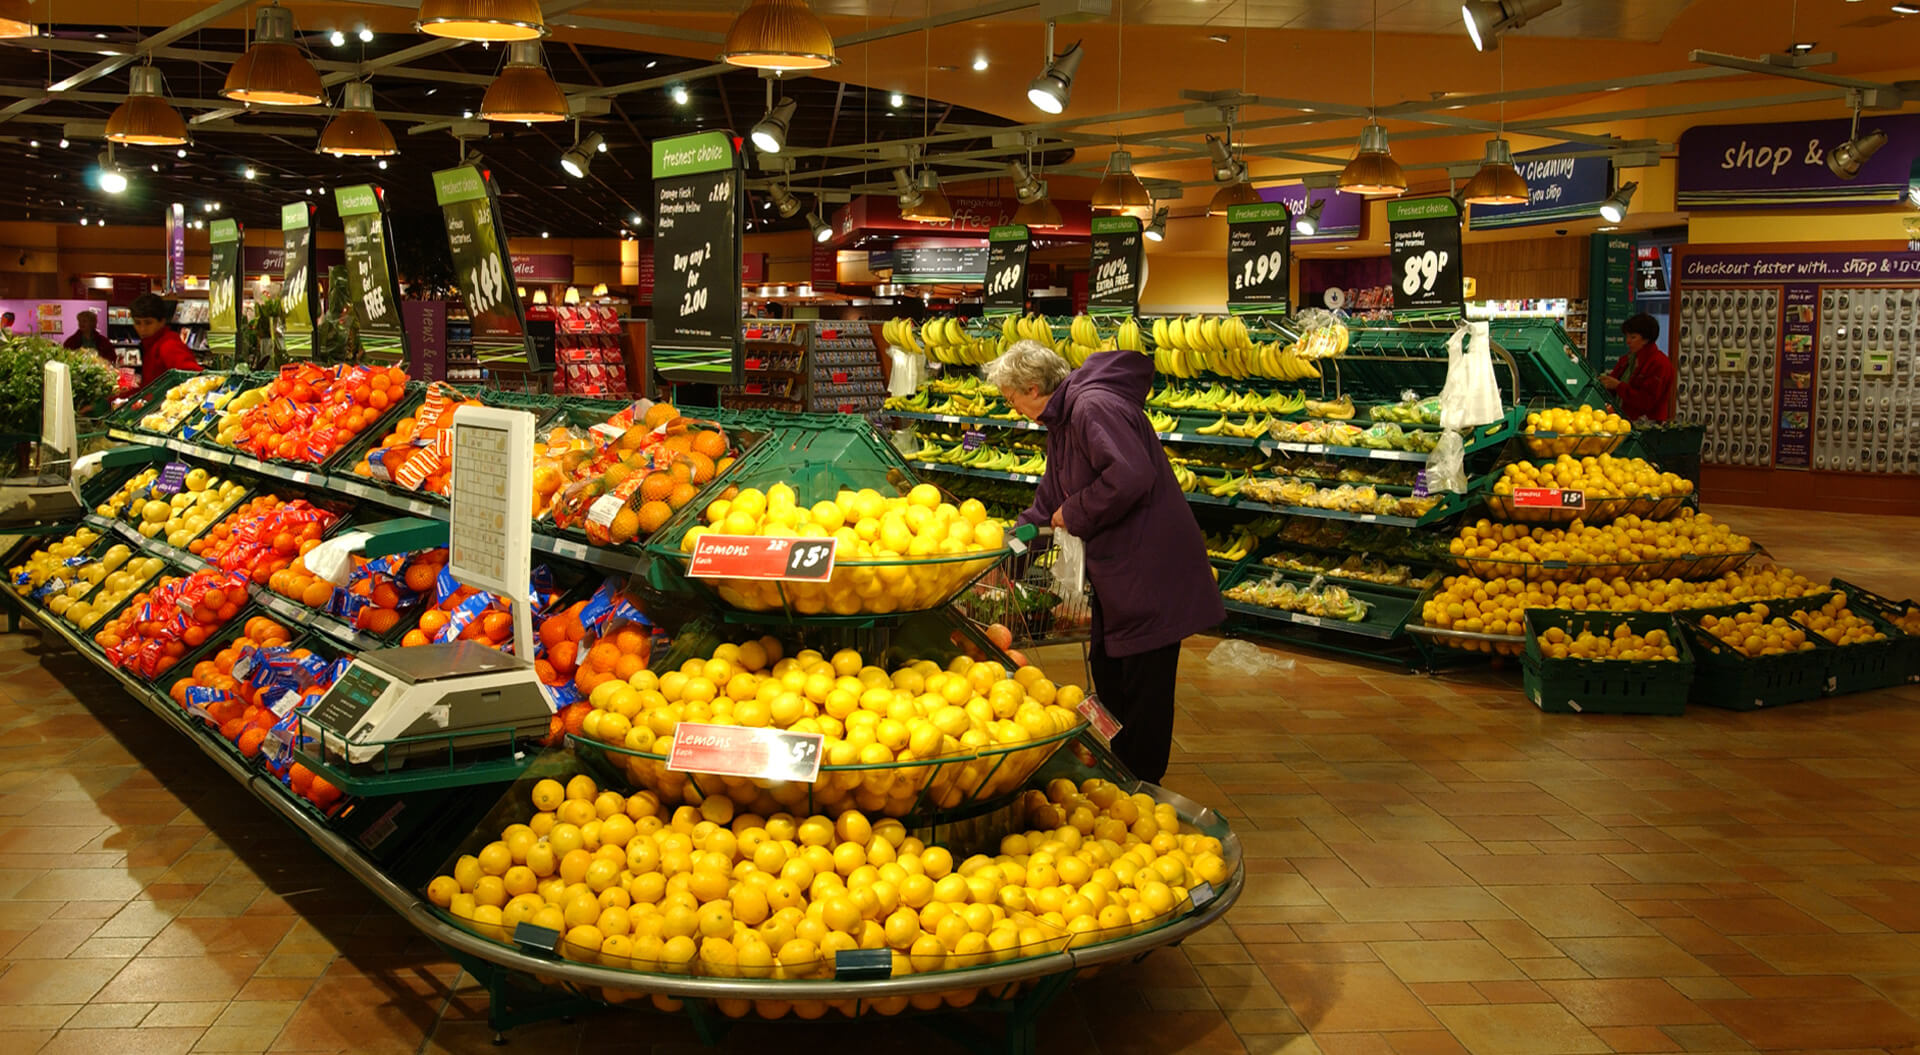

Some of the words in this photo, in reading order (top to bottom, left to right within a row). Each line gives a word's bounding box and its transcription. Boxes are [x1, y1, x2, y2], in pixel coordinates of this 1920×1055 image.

[663, 147, 696, 170] freshest
[697, 144, 723, 163] choice
[1721, 140, 1793, 175] shop
[1804, 139, 1824, 166] &
[1545, 184, 1562, 202] shop
[1398, 205, 1425, 216] freshest
[1426, 203, 1449, 214] choice
[673, 253, 688, 272] Buy
[689, 249, 704, 267] any
[705, 241, 711, 260] 2
[1096, 256, 1128, 281] 100%
[1235, 250, 1282, 290] £1.99
[1687, 260, 1750, 275] Checkout
[1753, 259, 1795, 276] faster
[1797, 258, 1840, 274] with...
[1842, 258, 1877, 276] shop
[1880, 257, 1890, 272] &
[469, 252, 502, 317] £1.49
[687, 269, 699, 288] for
[988, 264, 1021, 296] £1.49
[1096, 278, 1114, 293] EXTRA
[1115, 272, 1130, 287] FREE
[363, 285, 387, 321] FREE
[680, 287, 708, 317] £2.00
[423, 307, 434, 343] news
[698, 541, 749, 556] Lemons
[674, 747, 693, 756] Each
[677, 731, 731, 748] Lemons
[791, 740, 816, 762] 5p
